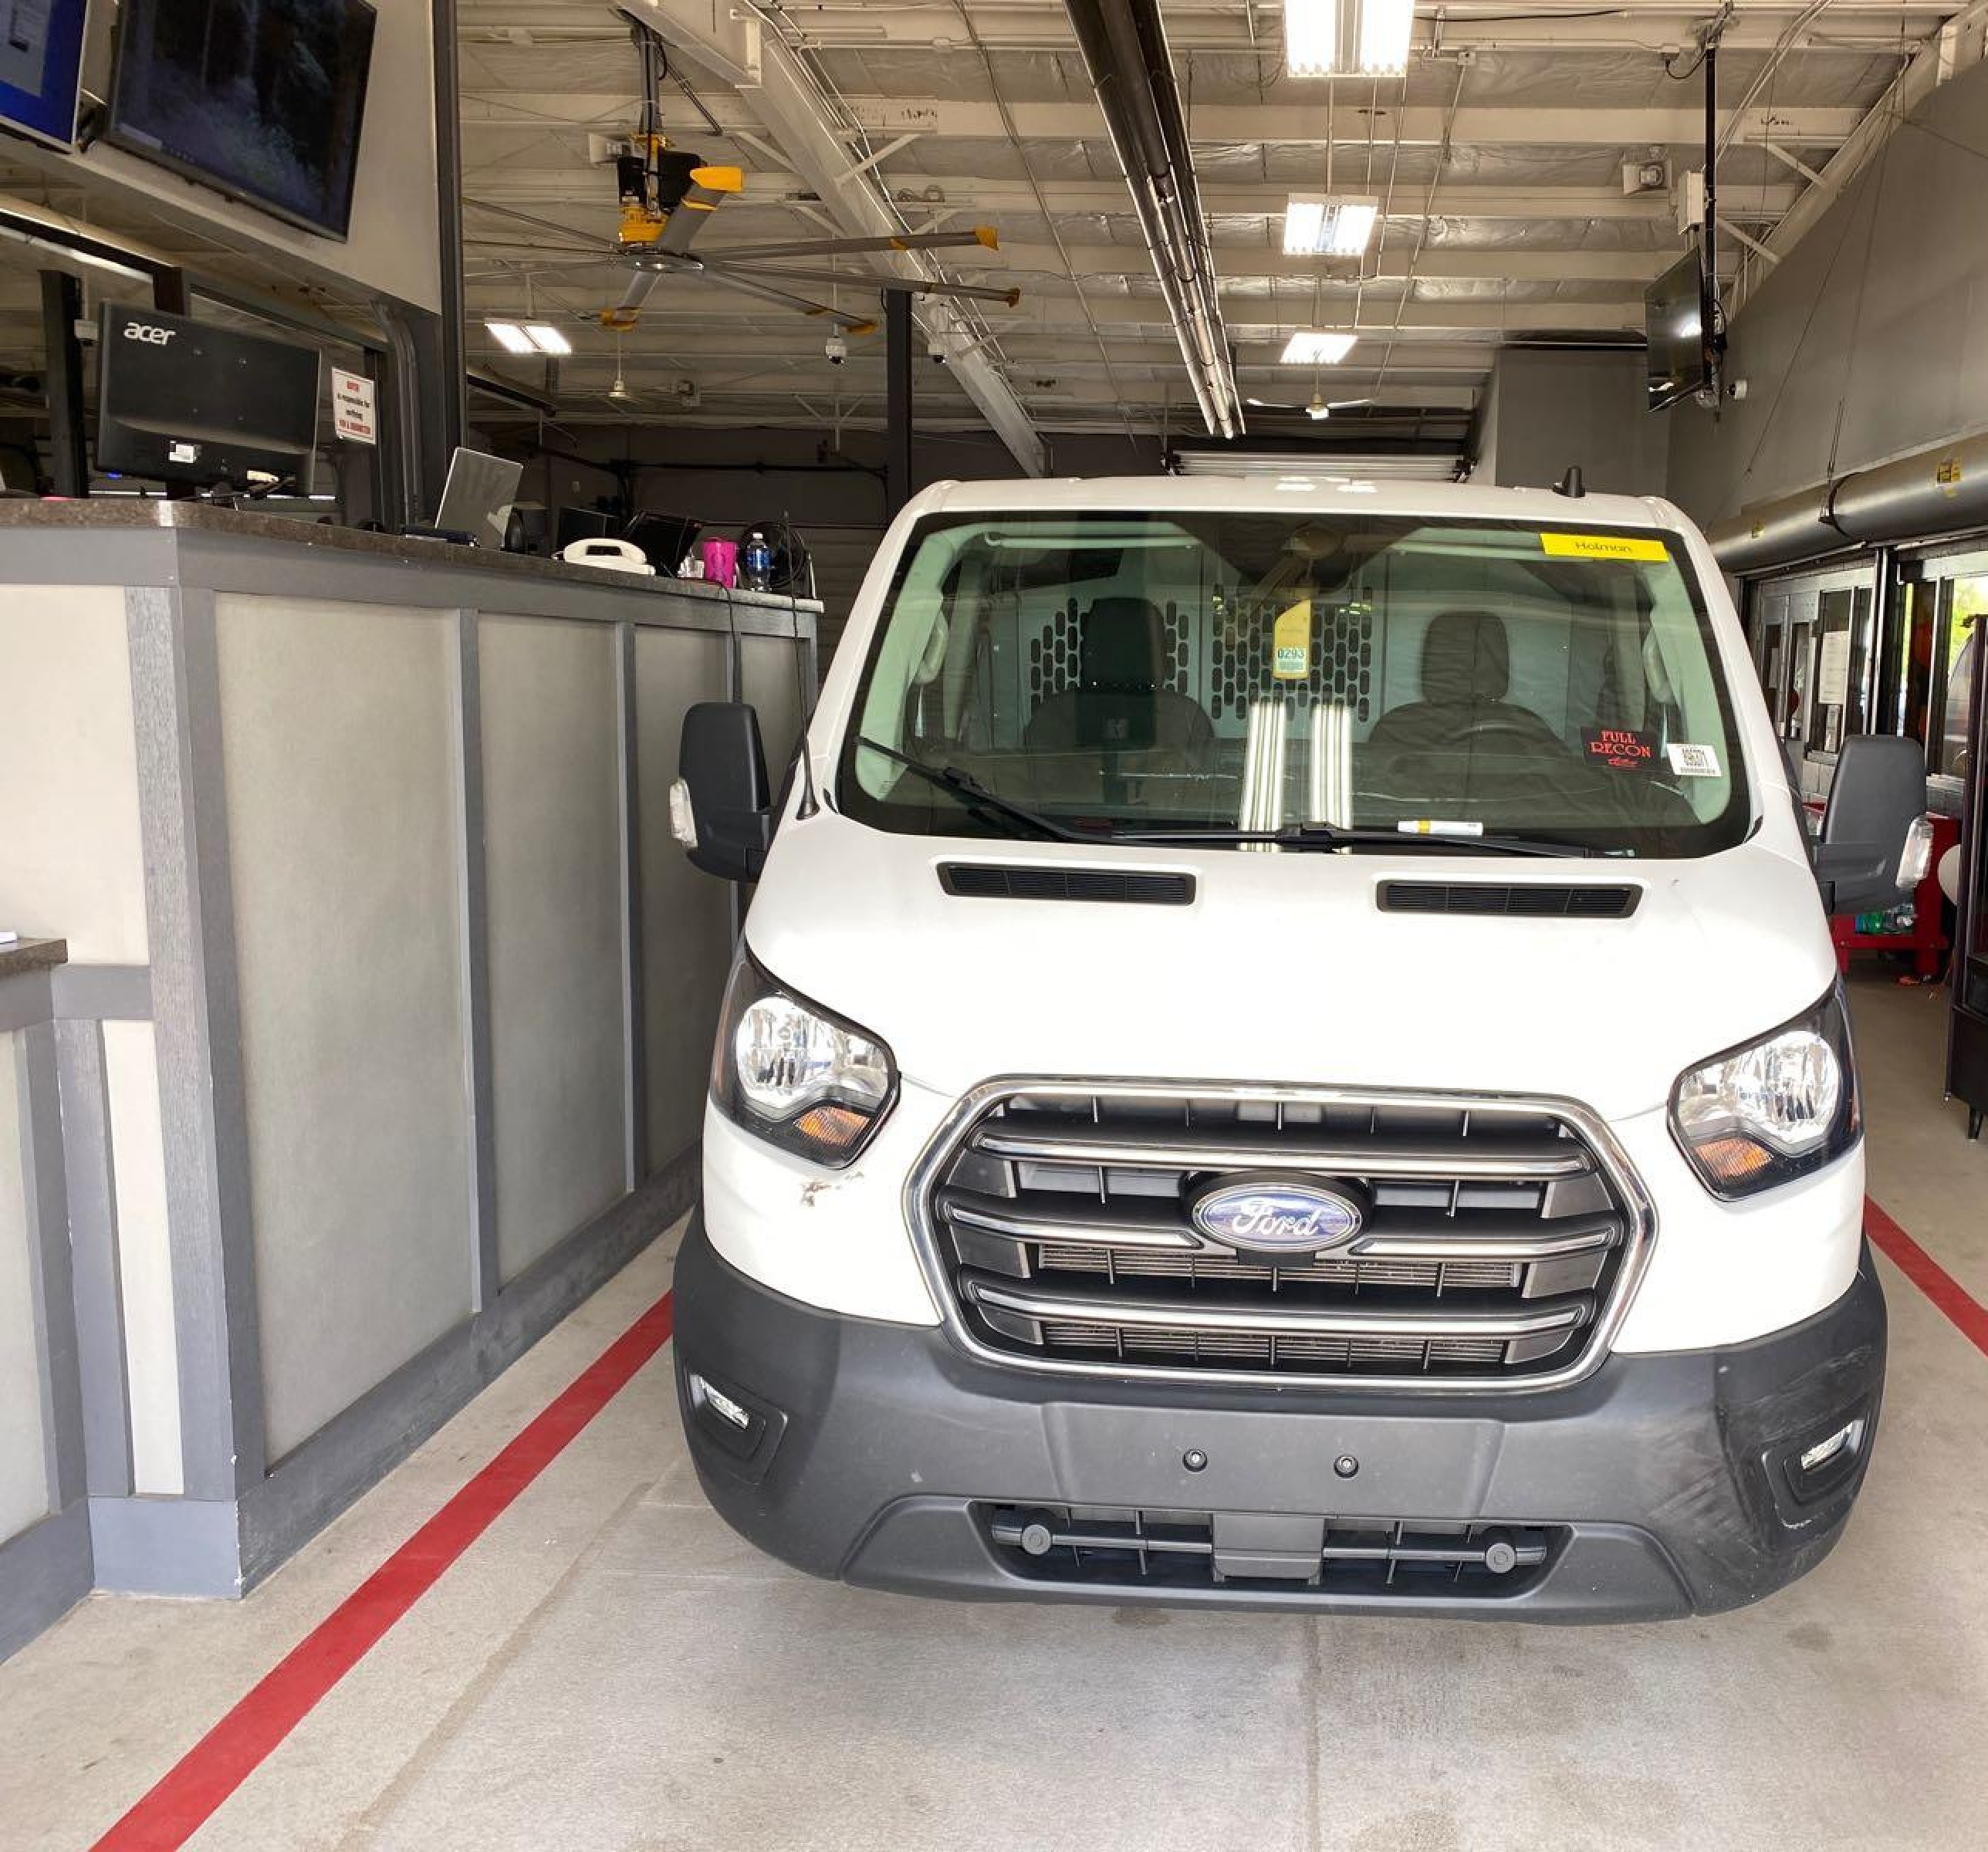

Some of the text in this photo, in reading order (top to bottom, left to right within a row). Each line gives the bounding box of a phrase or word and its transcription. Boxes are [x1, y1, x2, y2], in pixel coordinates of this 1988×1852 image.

[123, 322, 176, 346] acer
[1601, 731, 1636, 744] FULL
[1591, 742, 1651, 758] RECON
[1232, 1202, 1322, 1235] Ford
